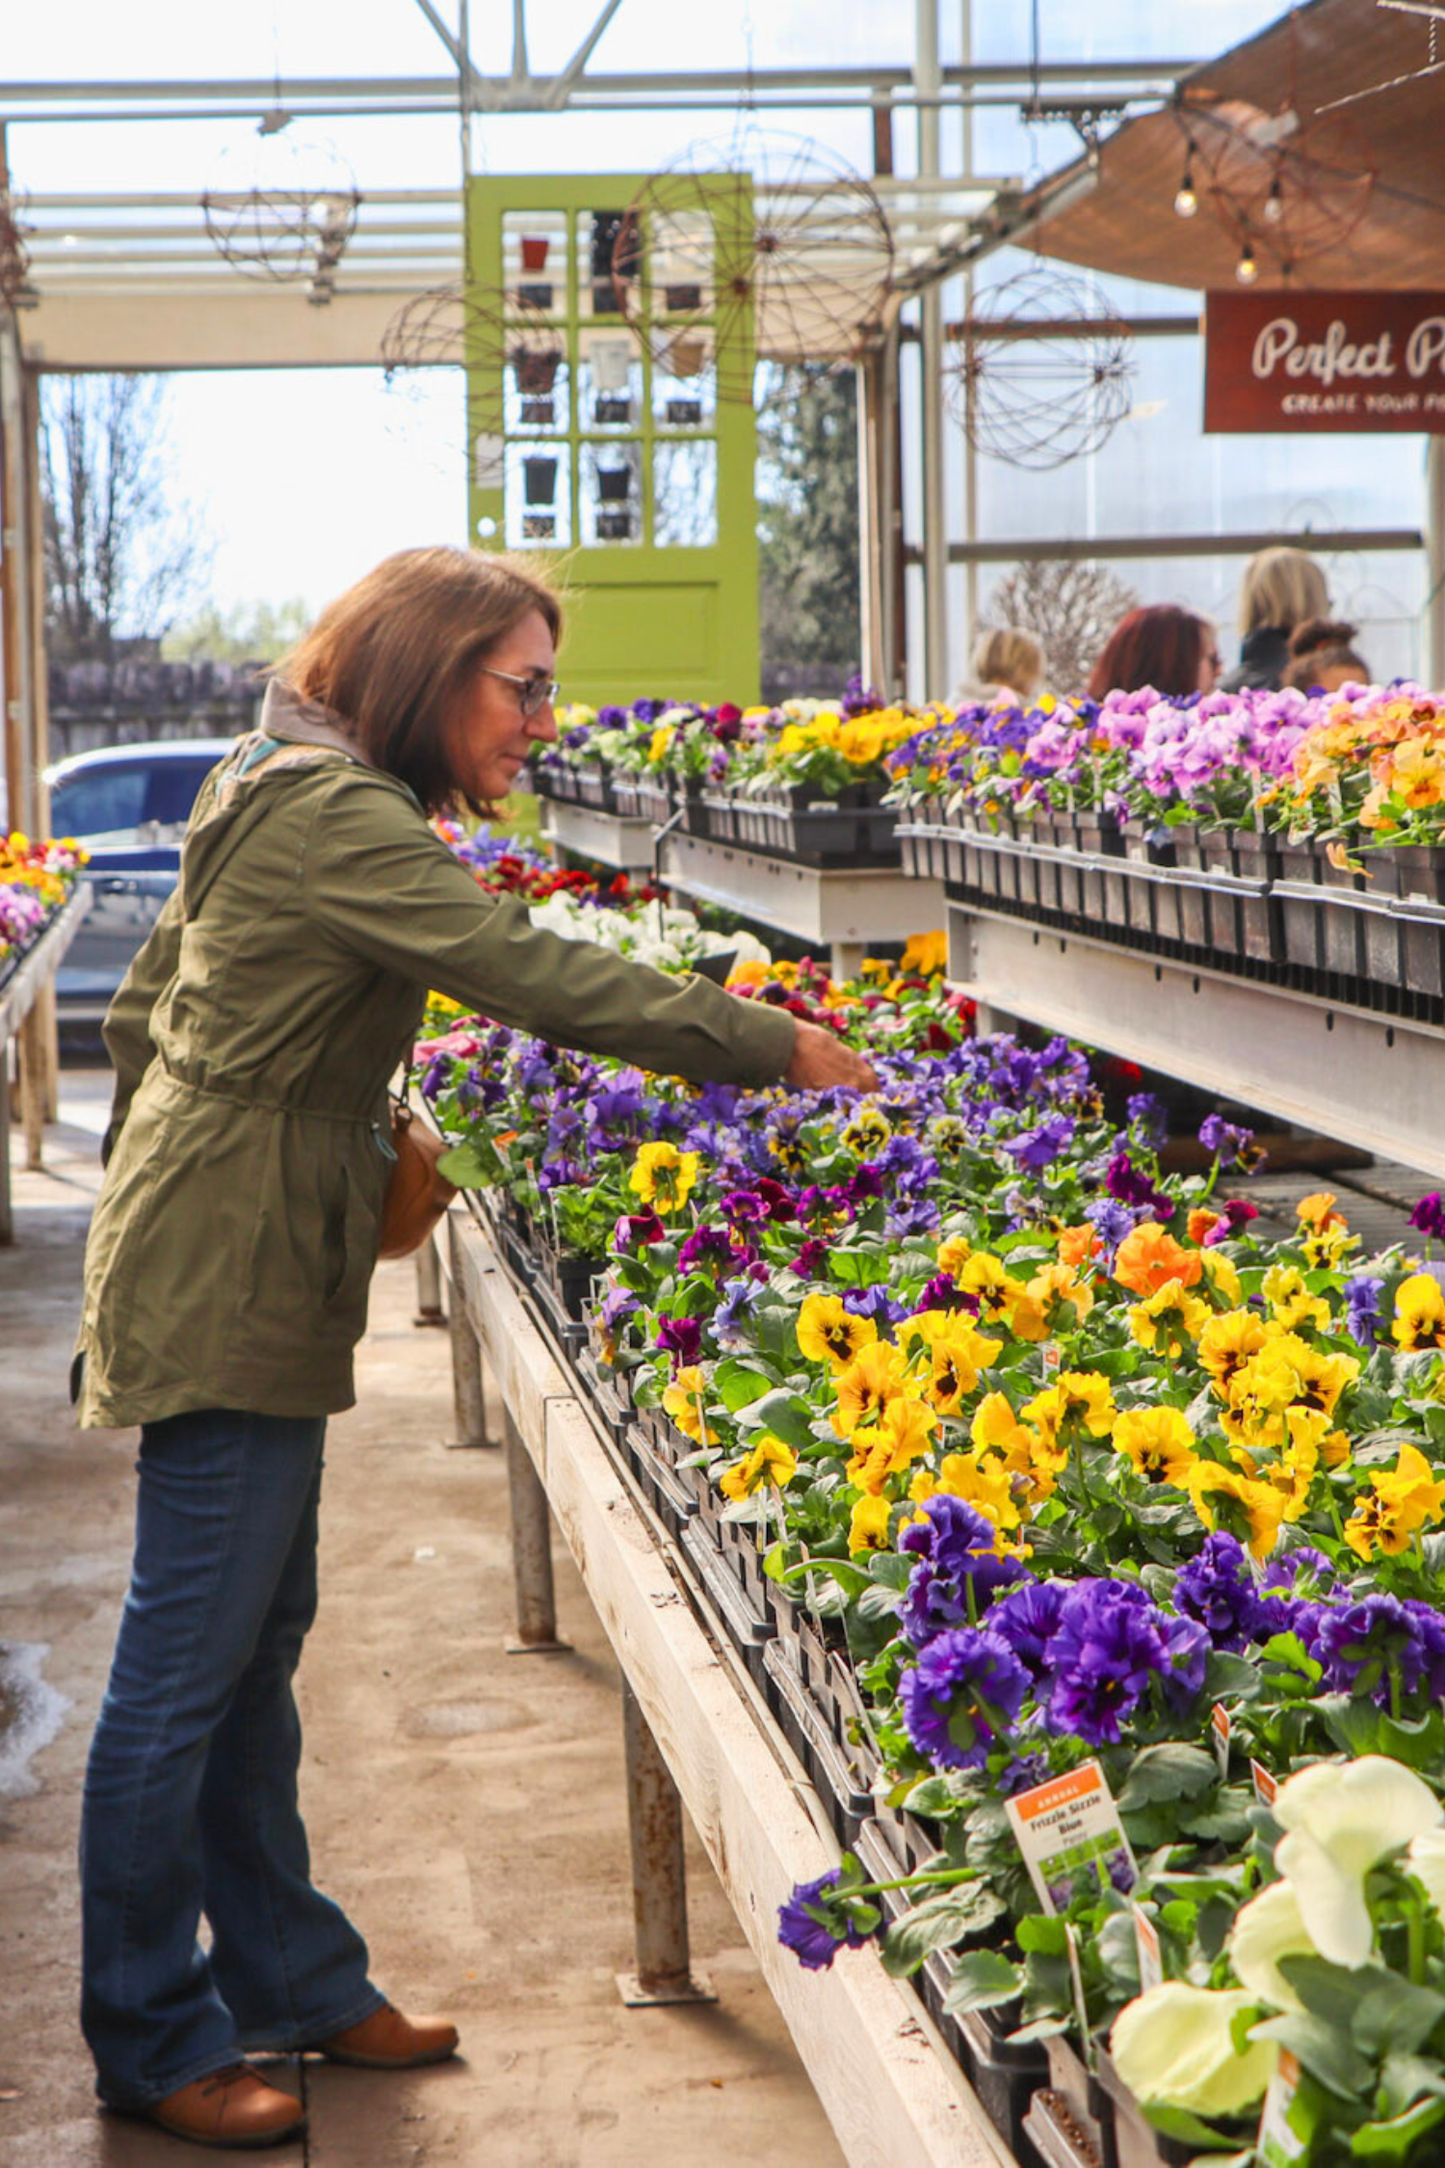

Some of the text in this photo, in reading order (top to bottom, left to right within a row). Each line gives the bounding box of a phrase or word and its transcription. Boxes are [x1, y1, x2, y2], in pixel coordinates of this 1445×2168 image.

[1252, 316, 1445, 386] Perfect P
[1281, 393, 1358, 414] CREATE
[1364, 393, 1419, 413] YOUR
[1037, 1785, 1079, 1809] ANNUAL
[1030, 1794, 1101, 1832] Frizzle Sizzle
[1058, 1818, 1083, 1835] Blue
